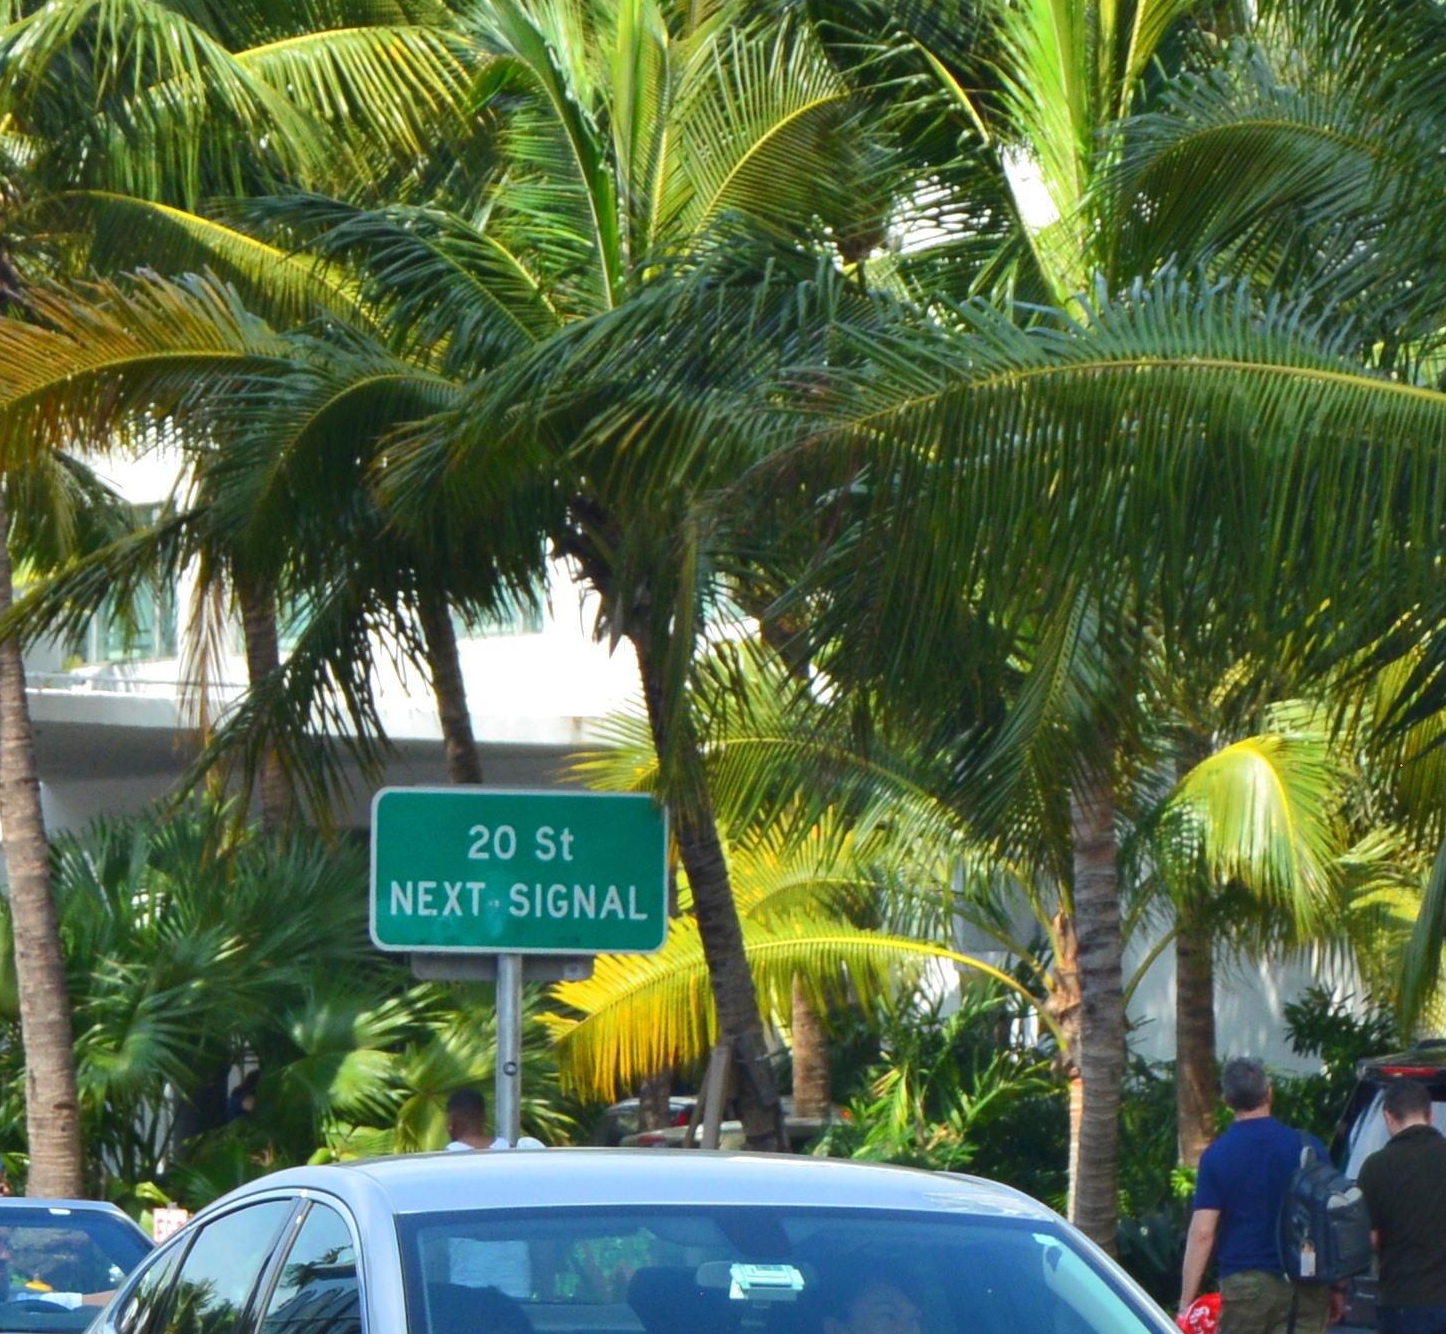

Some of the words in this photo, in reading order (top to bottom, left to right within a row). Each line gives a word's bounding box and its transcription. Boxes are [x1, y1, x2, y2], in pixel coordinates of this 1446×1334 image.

[468, 825, 516, 860] 20
[535, 826, 574, 861] St
[390, 880, 486, 917] NEXT
[509, 883, 649, 920] SIGNAL
